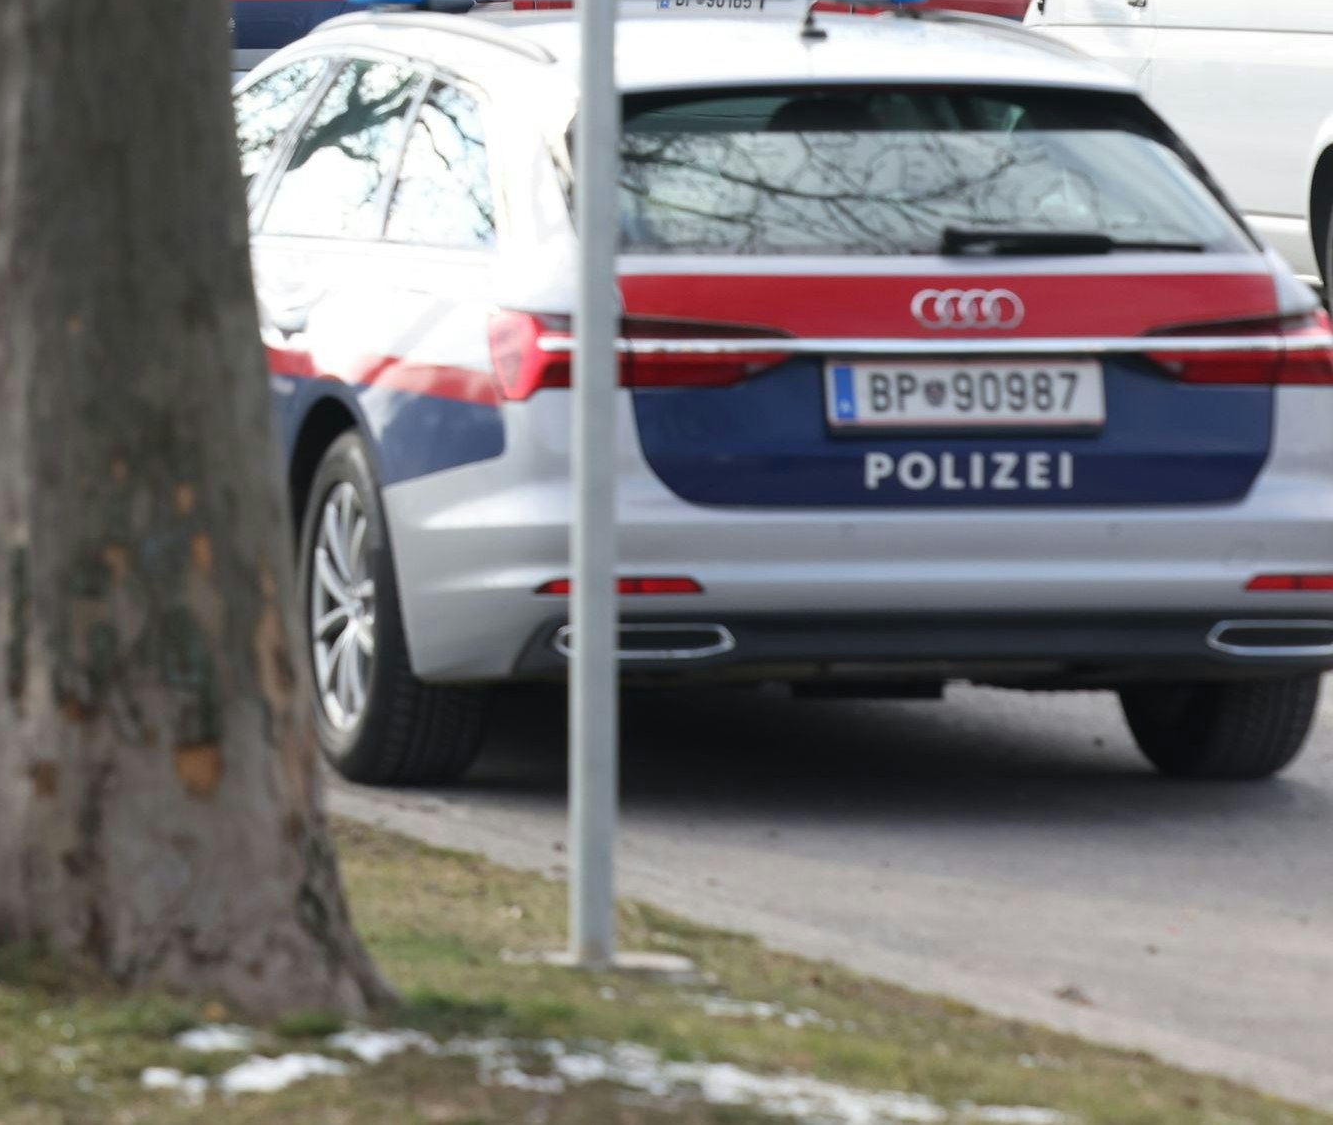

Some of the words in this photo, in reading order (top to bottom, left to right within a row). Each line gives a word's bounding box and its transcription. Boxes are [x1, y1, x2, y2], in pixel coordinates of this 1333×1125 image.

[868, 372, 918, 413] BP
[952, 371, 1079, 413] 90987
[864, 451, 1074, 490] POLIZEI
